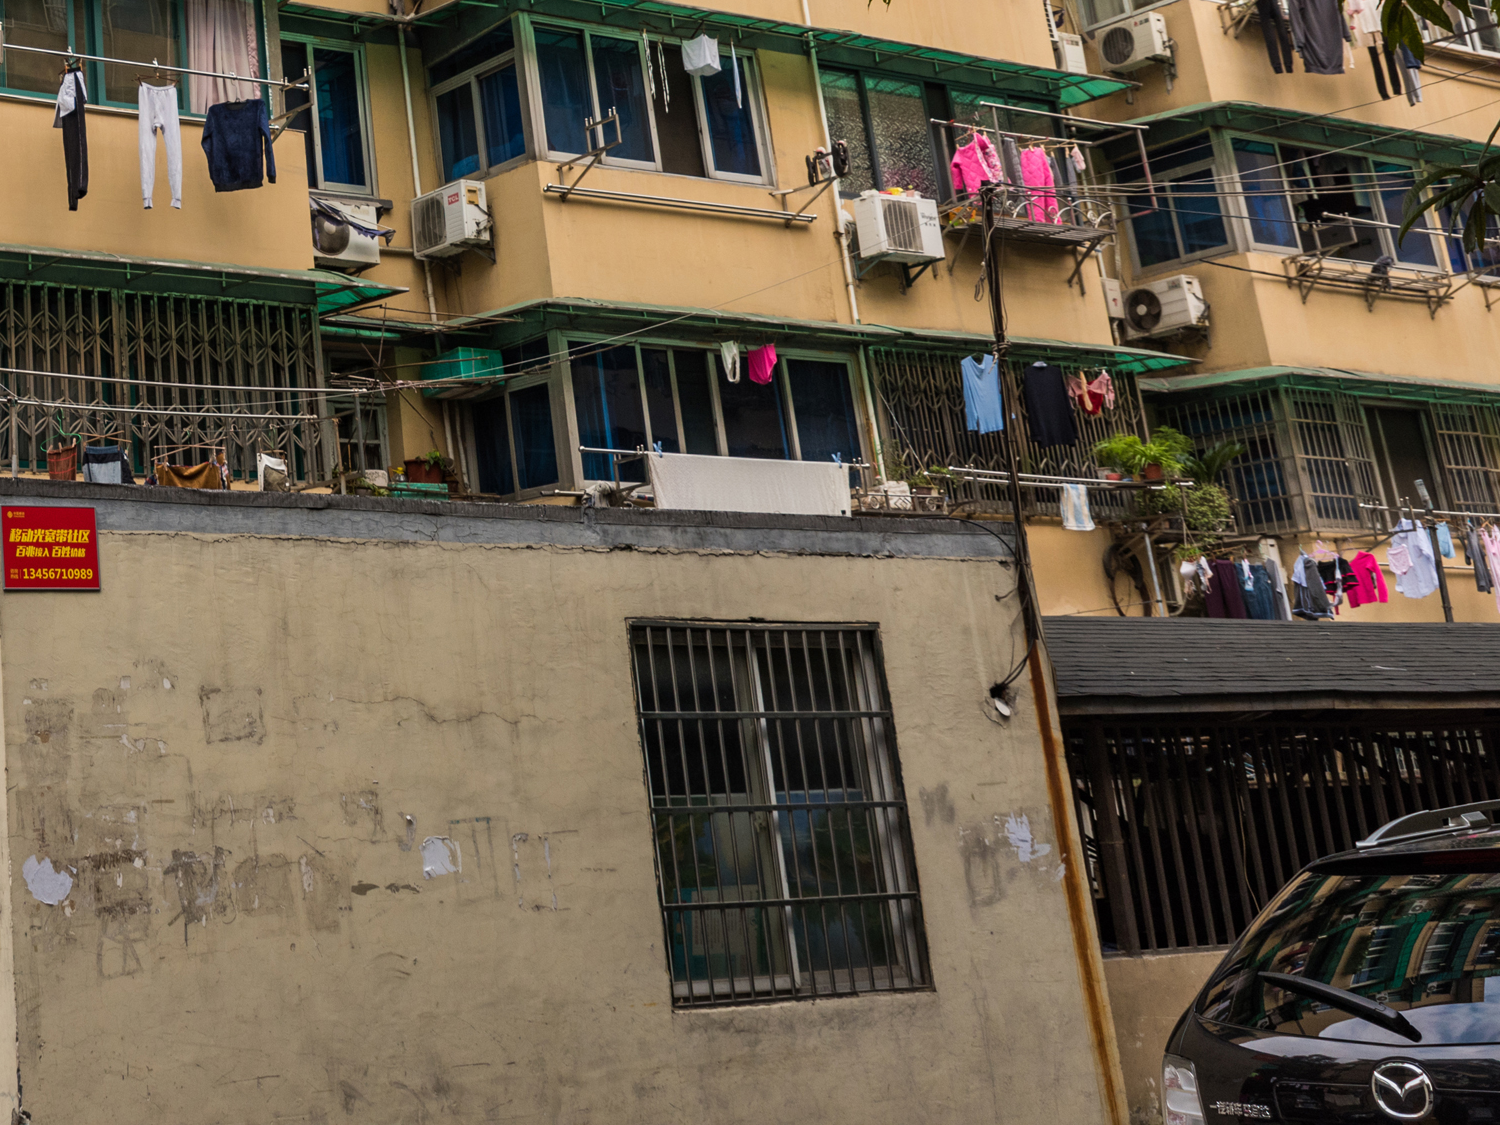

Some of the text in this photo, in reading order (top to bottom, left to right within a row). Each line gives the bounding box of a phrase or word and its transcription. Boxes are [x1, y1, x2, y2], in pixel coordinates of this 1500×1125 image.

[9, 528, 90, 543] 移动光宽带社区
[23, 568, 93, 579] 13456710989
